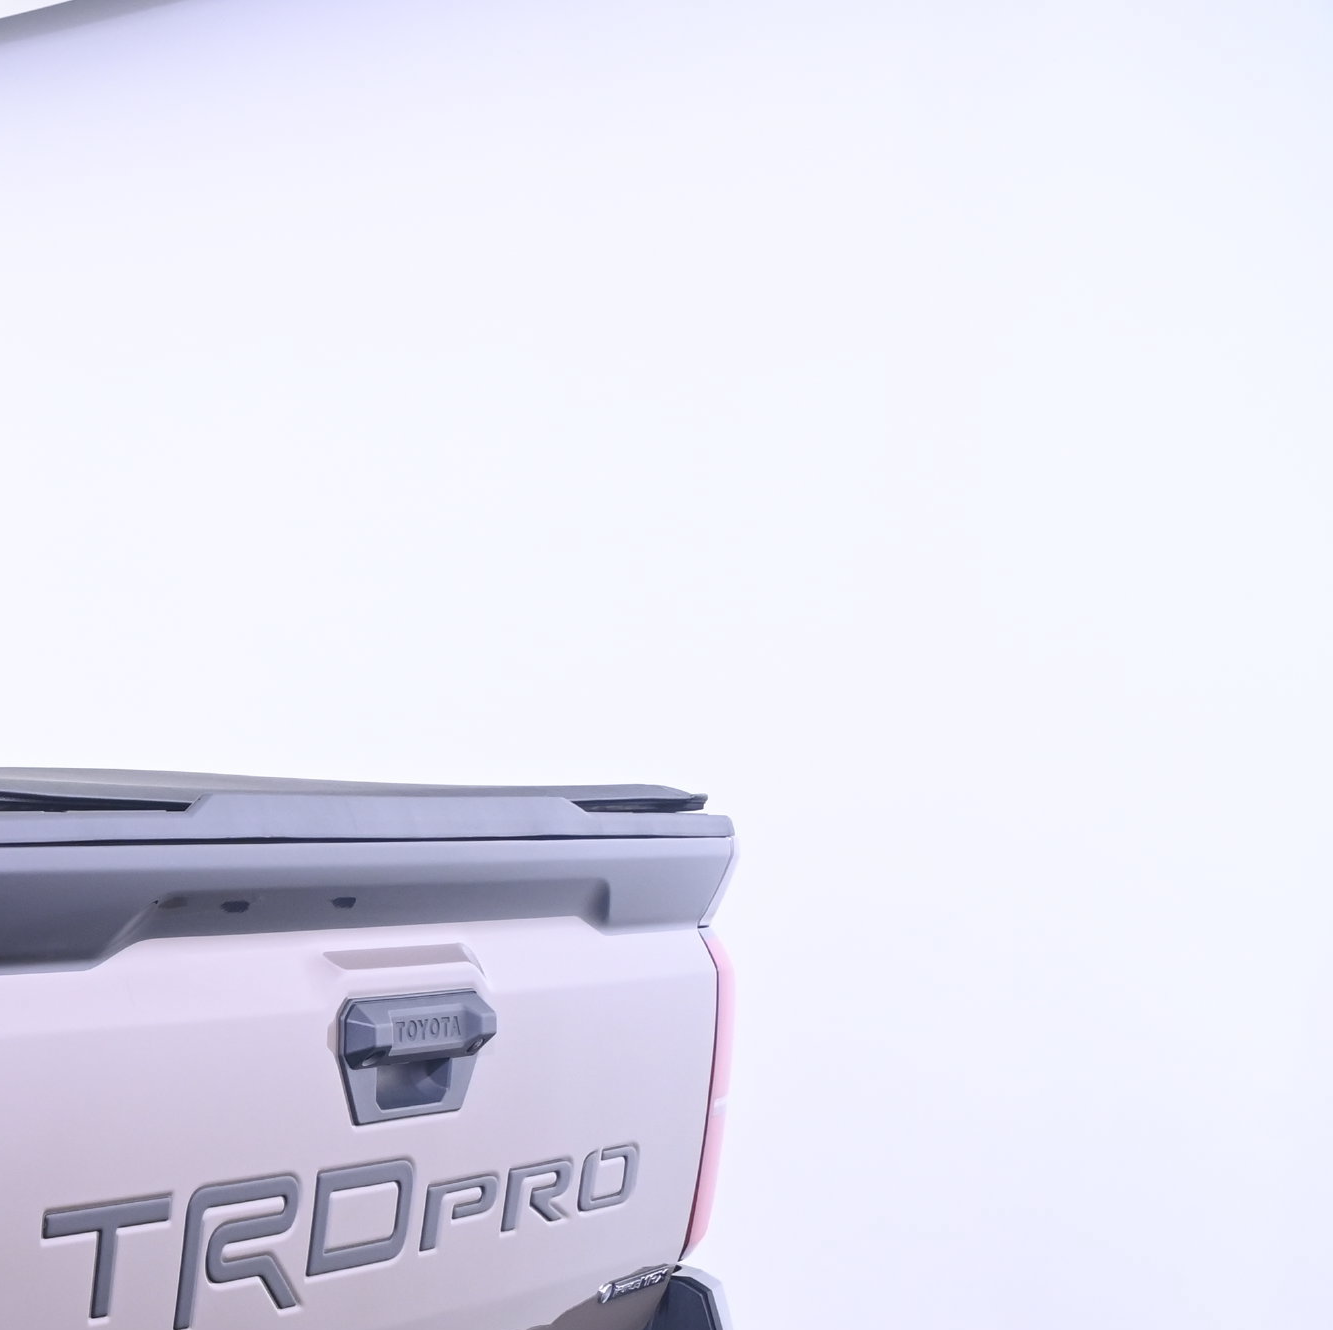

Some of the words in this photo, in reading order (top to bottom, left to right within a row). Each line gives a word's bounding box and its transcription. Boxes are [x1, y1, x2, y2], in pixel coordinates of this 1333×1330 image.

[395, 1015, 462, 1042] TOYOTA
[42, 1158, 416, 1330] TRD
[419, 1142, 639, 1252] PRO
